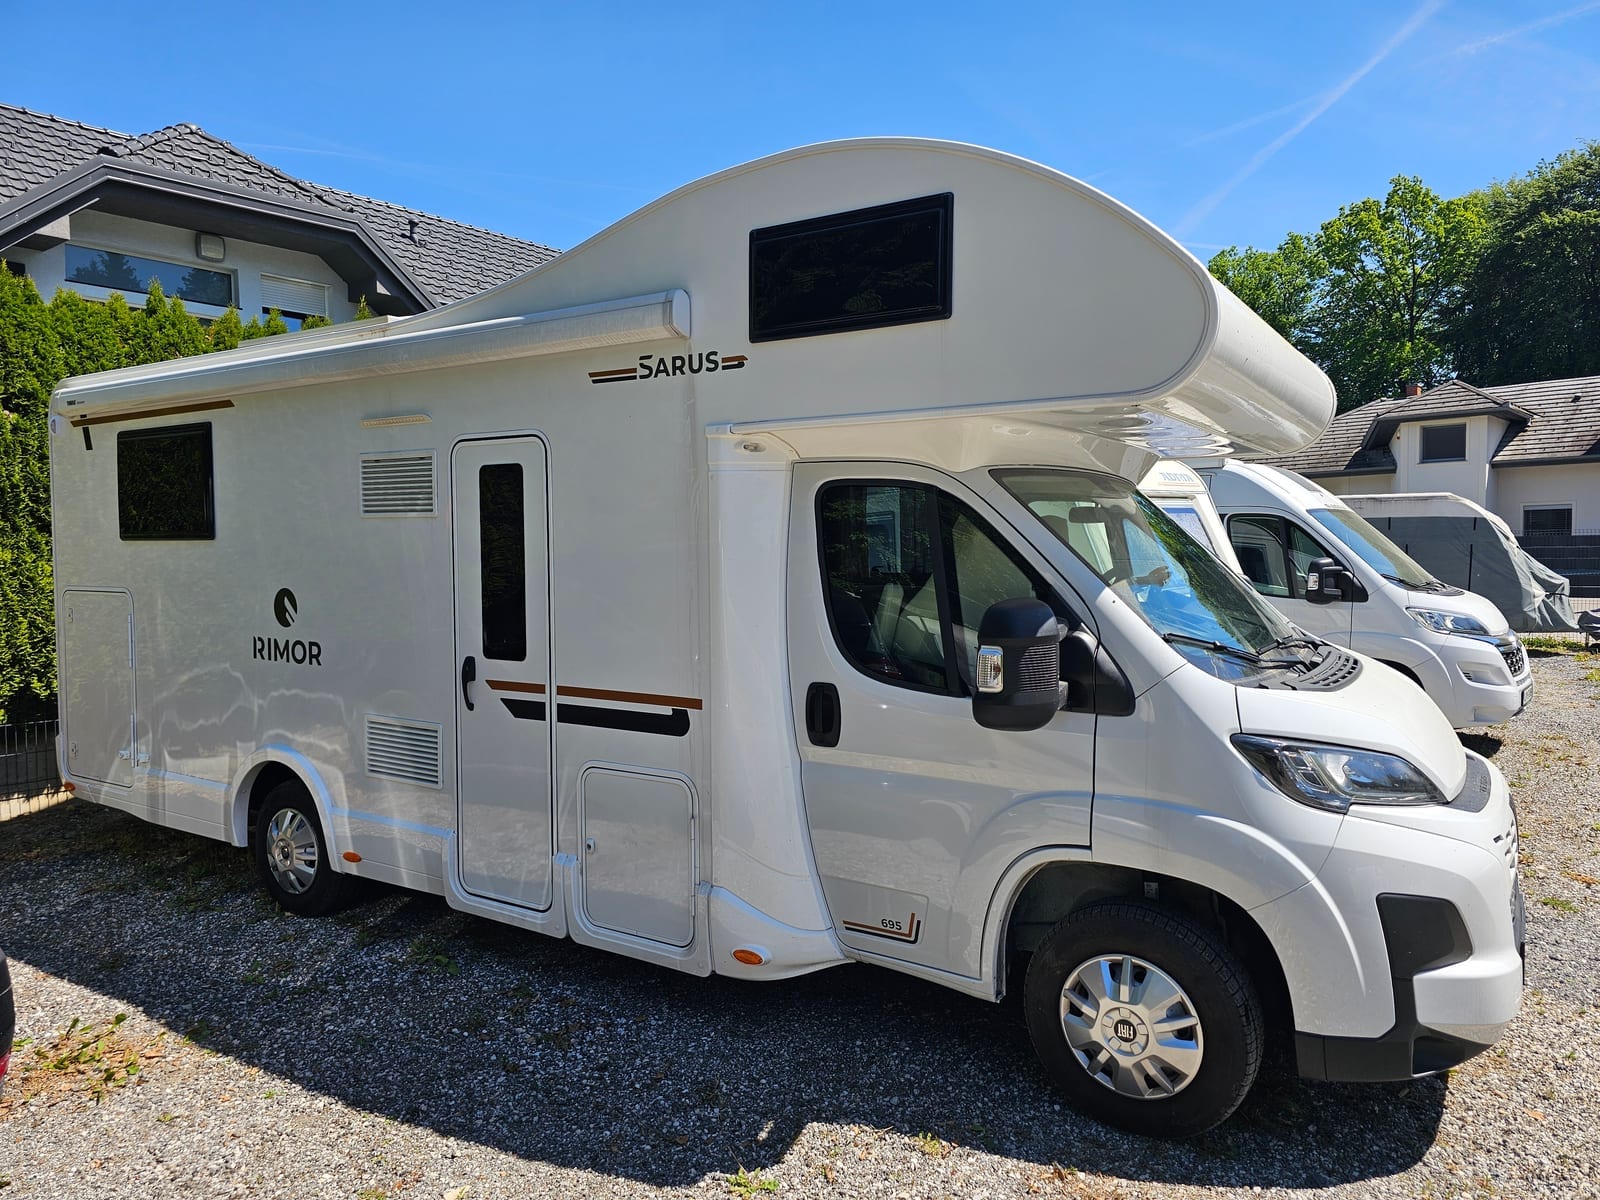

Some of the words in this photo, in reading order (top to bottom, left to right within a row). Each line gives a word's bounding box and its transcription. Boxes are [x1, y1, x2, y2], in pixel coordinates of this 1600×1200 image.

[639, 351, 720, 379] SARUS
[253, 635, 322, 666] RIMOR
[881, 918, 902, 930] 695
[1117, 1023, 1134, 1039] FIAT
